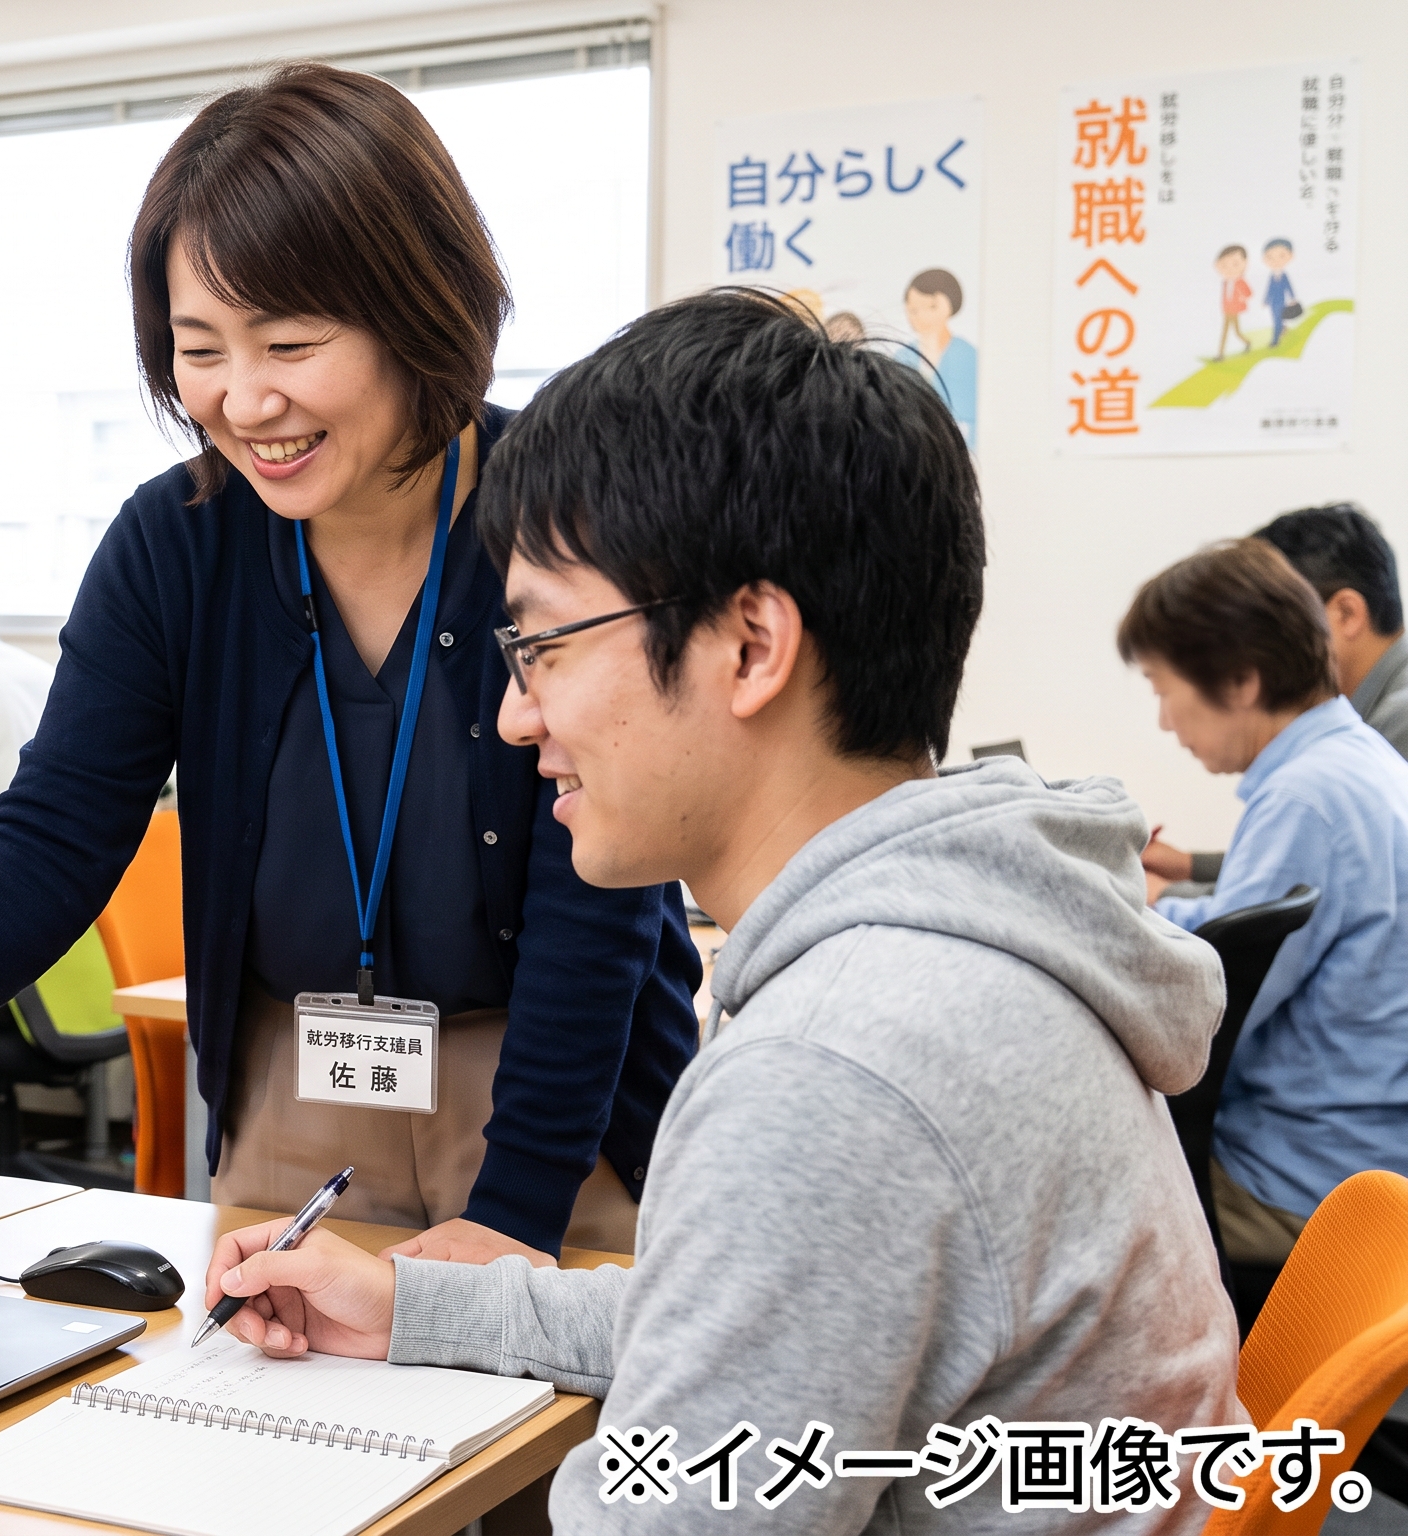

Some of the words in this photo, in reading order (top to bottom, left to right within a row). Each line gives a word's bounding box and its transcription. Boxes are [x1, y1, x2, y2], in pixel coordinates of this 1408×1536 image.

[727, 137, 967, 208] 自分らしく
[725, 216, 815, 273] 働く
[1067, 96, 1148, 436] 就職への道
